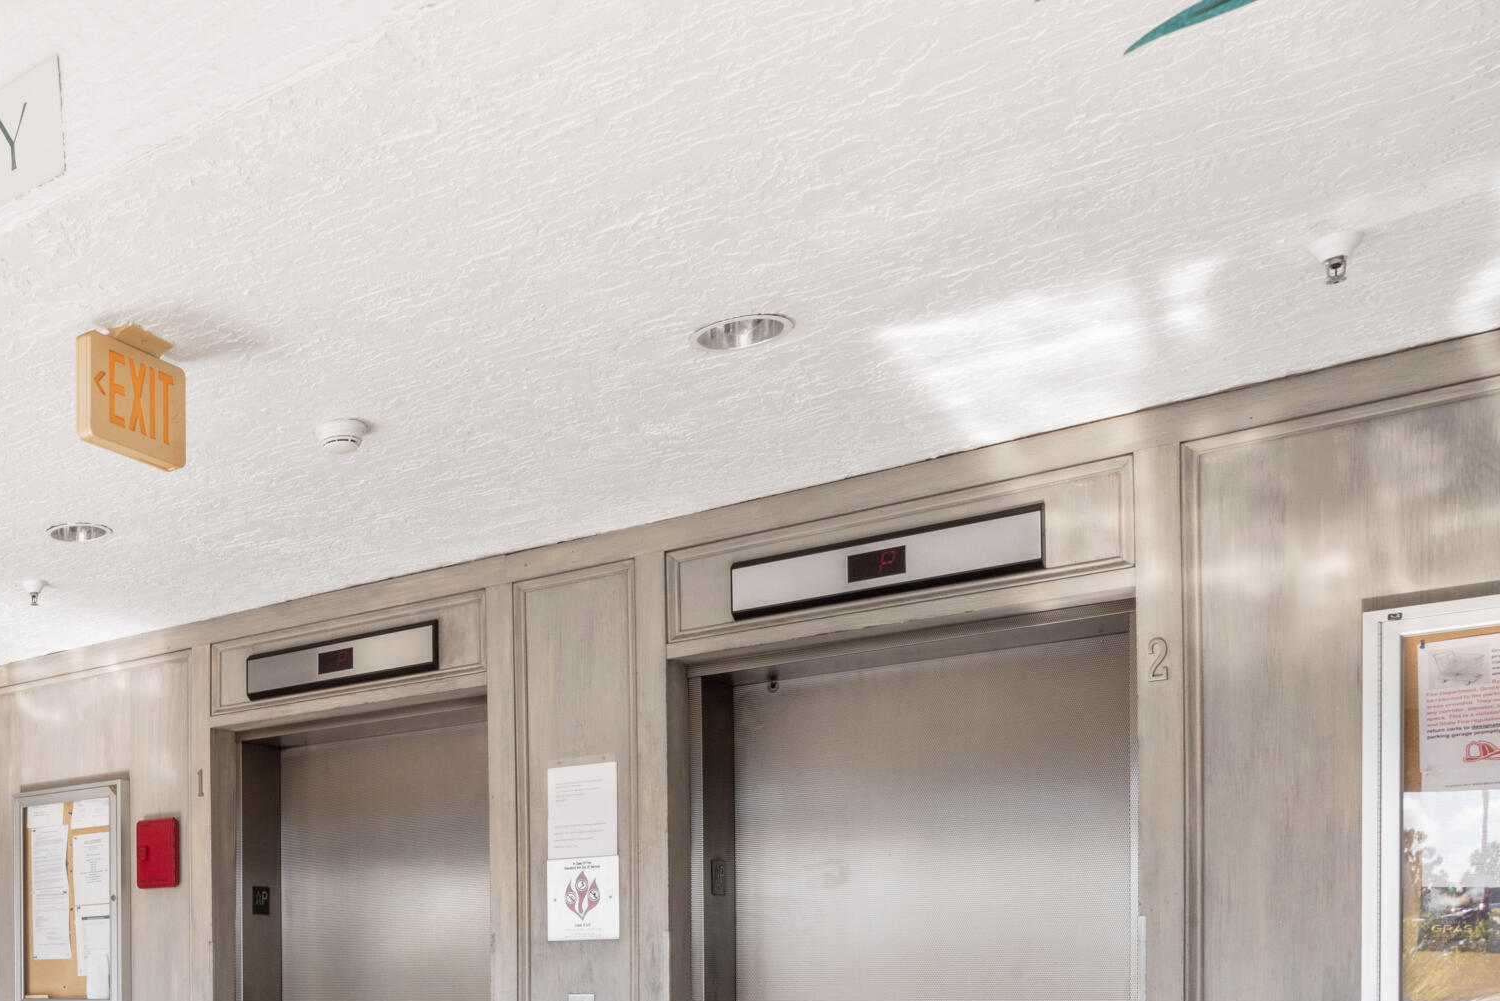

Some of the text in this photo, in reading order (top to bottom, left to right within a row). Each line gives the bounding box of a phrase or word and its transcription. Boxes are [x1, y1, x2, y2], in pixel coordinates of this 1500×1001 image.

[108, 349, 174, 445] EXIT
[878, 550, 896, 575] P
[1147, 637, 1169, 683] 2
[196, 768, 205, 797] 1
